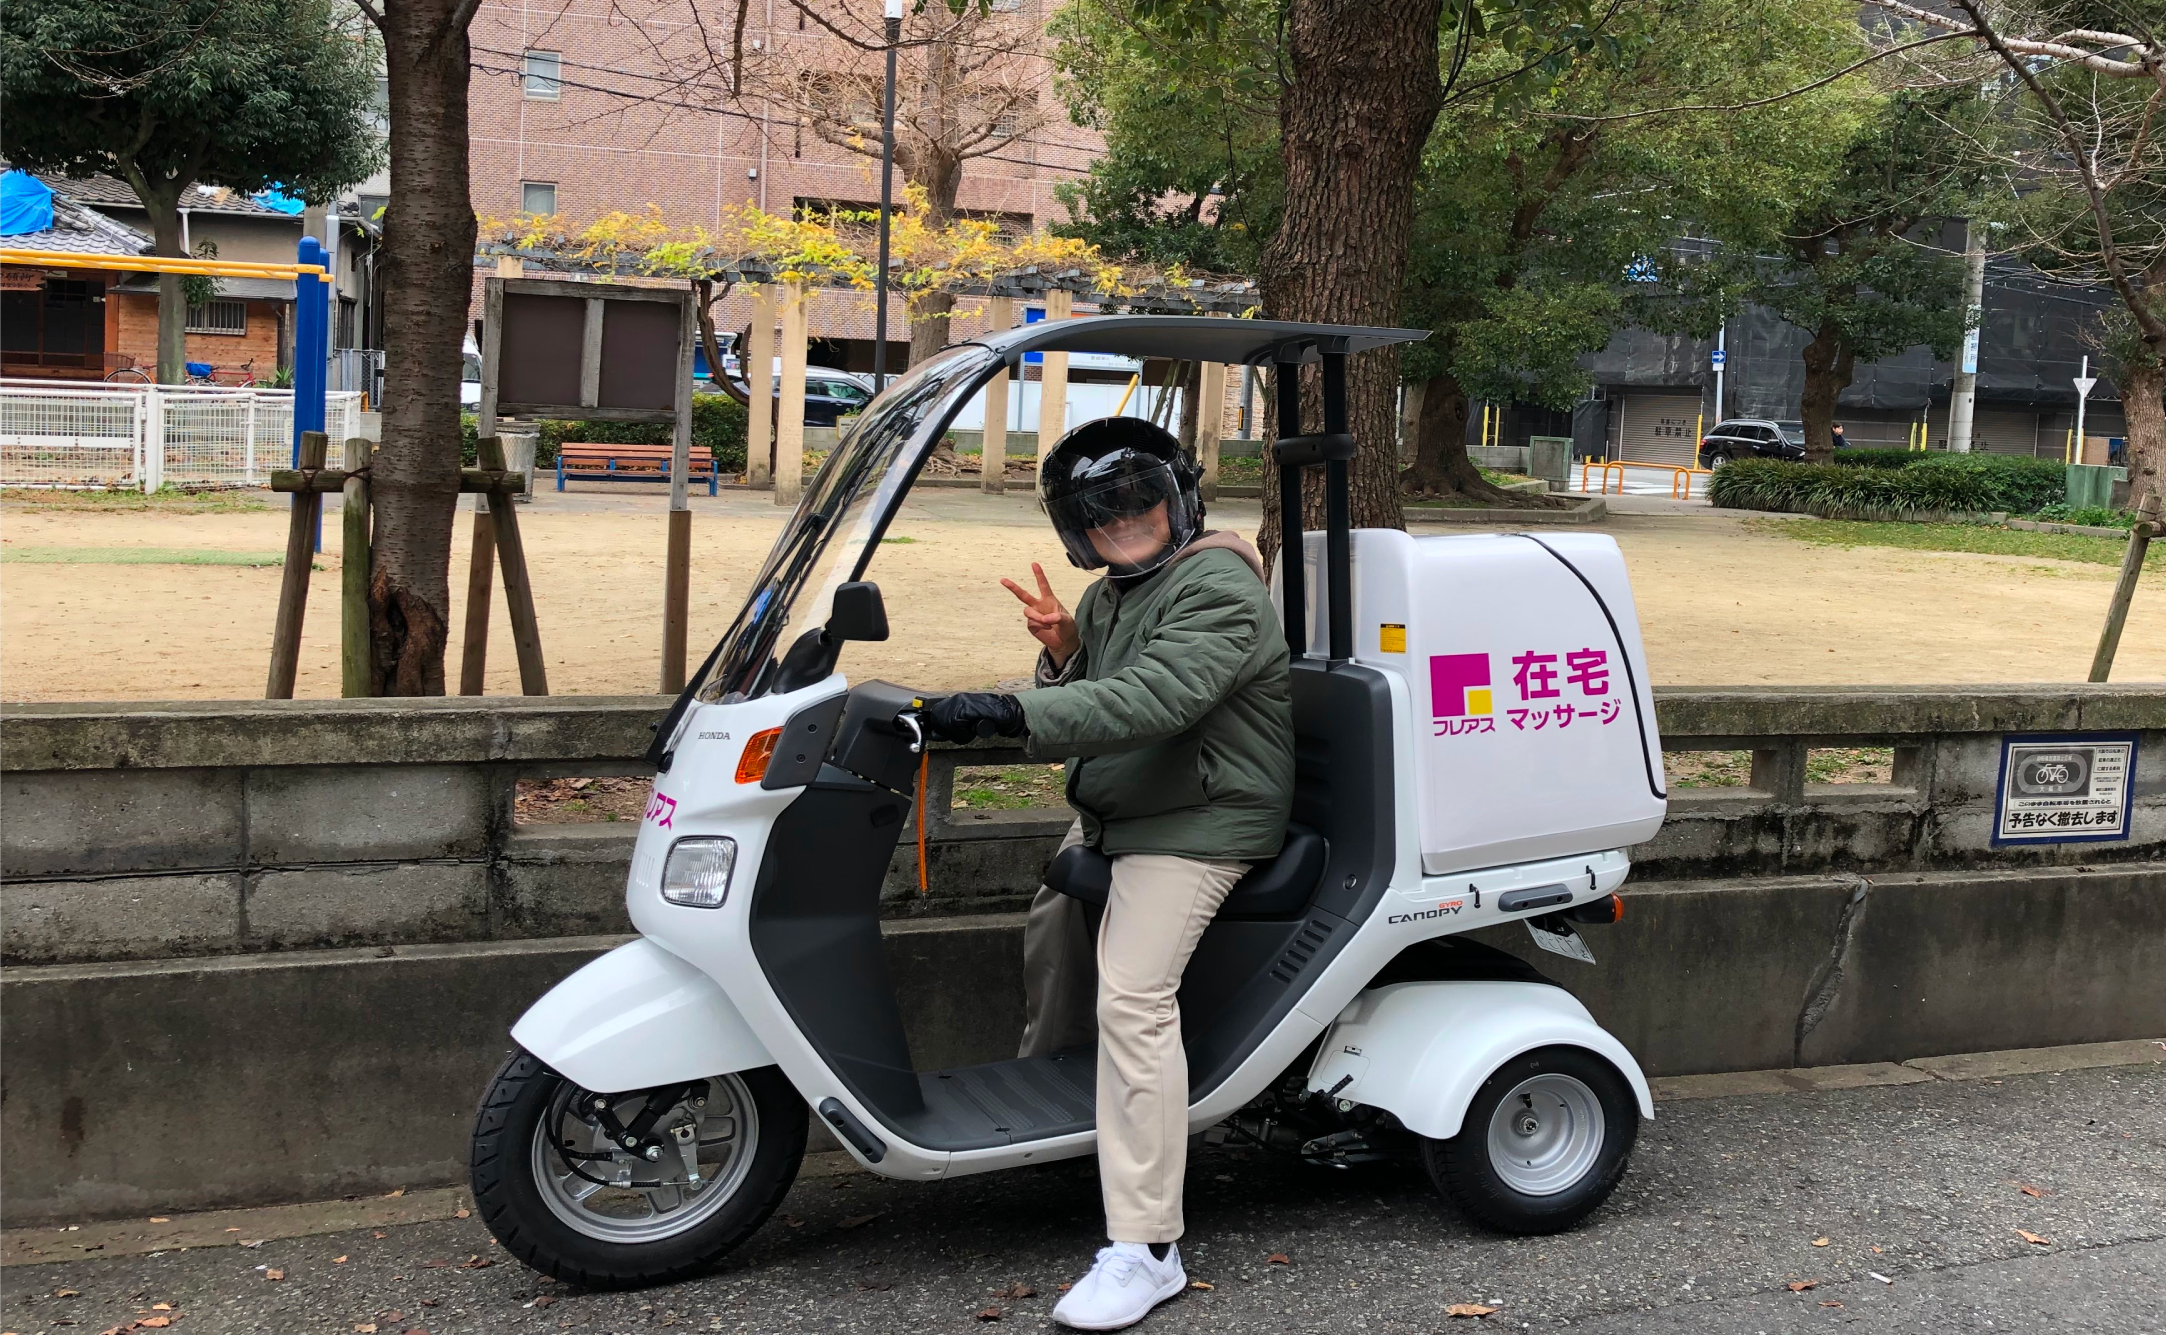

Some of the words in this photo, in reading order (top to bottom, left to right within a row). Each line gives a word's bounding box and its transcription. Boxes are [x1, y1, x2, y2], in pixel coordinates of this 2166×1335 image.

[1655, 426, 1692, 437] 駐車禁止
[1512, 647, 1609, 701] 在宅
[1507, 698, 1621, 731] マッサージ
[698, 731, 731, 740] HONDA
[1433, 717, 1495, 737] フレアス
[2009, 810, 2117, 828] 予告なく撤去します
[1438, 900, 1464, 909] GYRO
[1388, 906, 1463, 925] CANOPY
